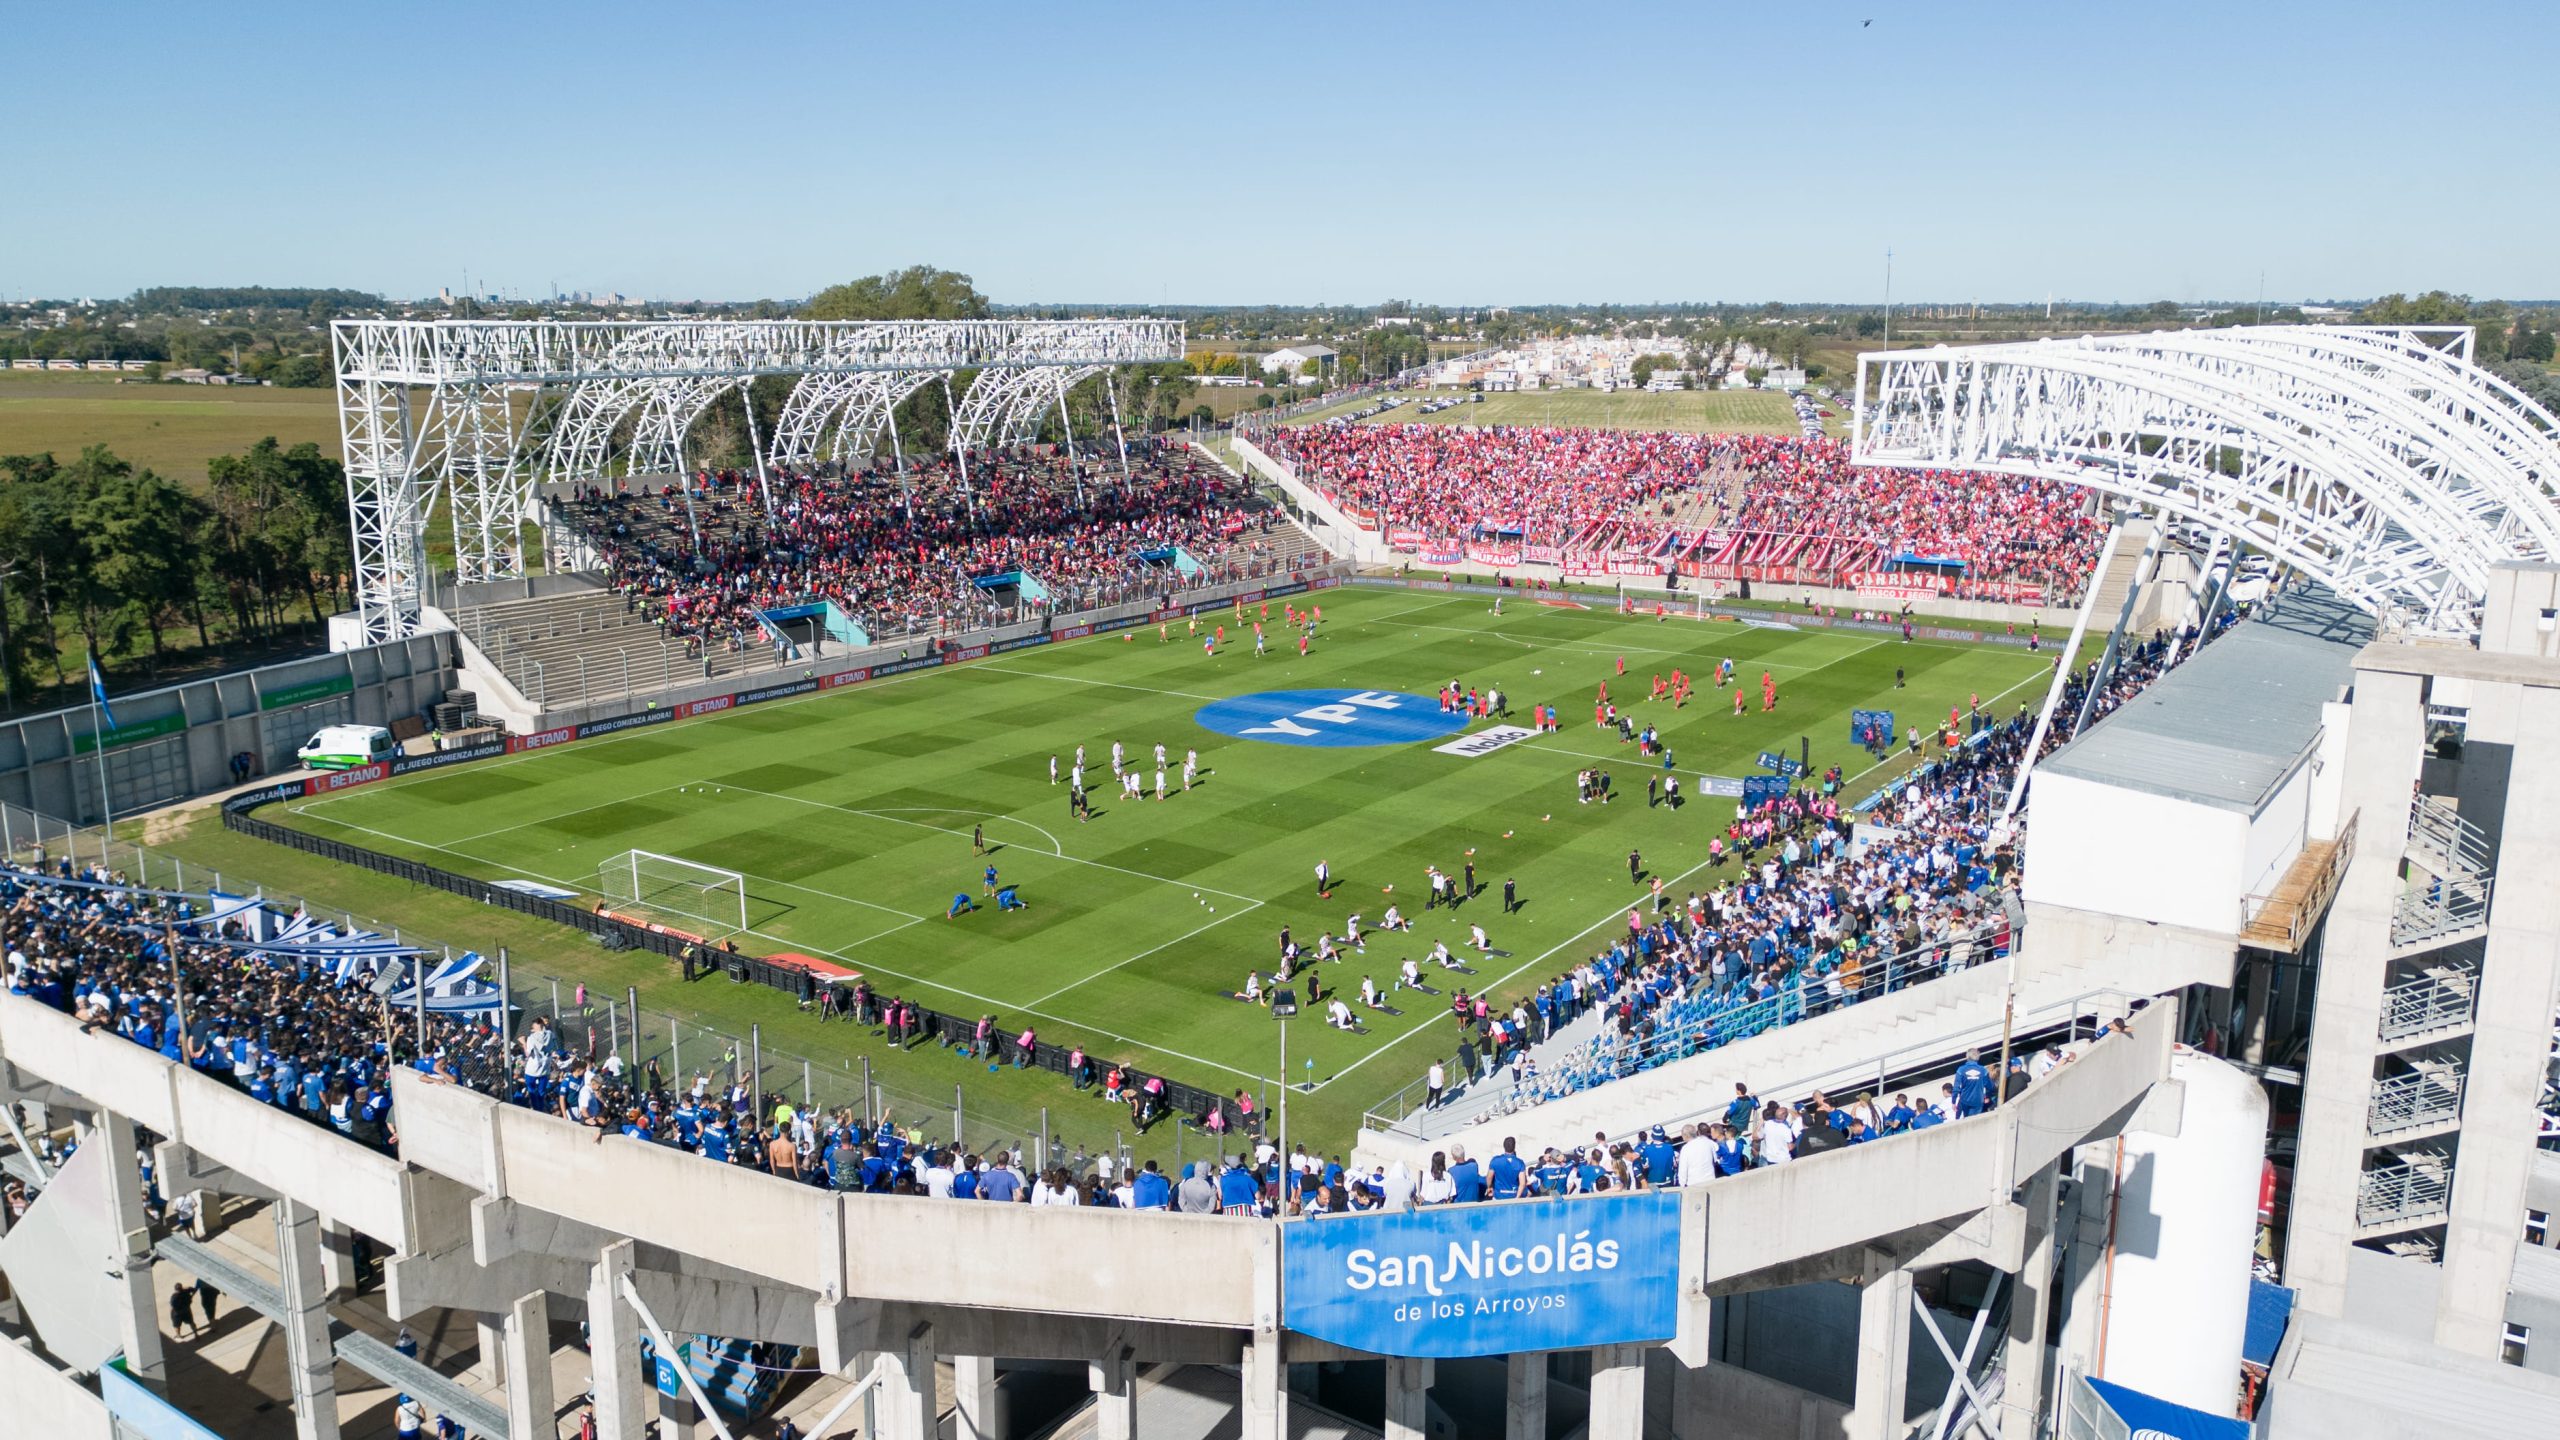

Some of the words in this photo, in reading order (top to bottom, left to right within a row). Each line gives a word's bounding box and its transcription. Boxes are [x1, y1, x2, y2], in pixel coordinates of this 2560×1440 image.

[1701, 564, 1733, 578] BANDA
[1743, 567, 1756, 579] DE
[1850, 573, 1948, 590] CARRANZA
[1533, 591, 1562, 600] BETANO
[1790, 615, 1824, 626] BETANO
[1862, 622, 1893, 631] COMIENZA
[1064, 627, 1089, 640] BETANO
[1936, 629, 1974, 641] BETANO
[1996, 636, 2015, 644] JUEGO
[957, 649, 984, 661] BETANO
[834, 671, 865, 685] BETANO
[748, 692, 765, 701] JUEGO
[767, 686, 795, 698] COMIENZA
[796, 682, 817, 692] AHORA!
[692, 698, 728, 714] BETANO
[1238, 691, 1402, 736] YPF
[591, 721, 612, 732] JUEGO
[613, 716, 646, 728] COMIENZA
[647, 711, 672, 721] AHORA!
[527, 730, 569, 748] BETANO
[1456, 731, 1528, 753] Naldo
[393, 762, 405, 774] ¡EL
[407, 757, 432, 769] JUEGO
[433, 750, 473, 764] COMIENZA
[473, 745, 503, 757] AHORA!
[330, 766, 381, 788] BETANO
[1346, 1249, 1443, 1296] San
[1440, 1230, 1620, 1283] Nicolás
[1394, 1304, 1422, 1322] de
[1432, 1300, 1465, 1319] los
[1474, 1294, 1566, 1316] Arroyos
